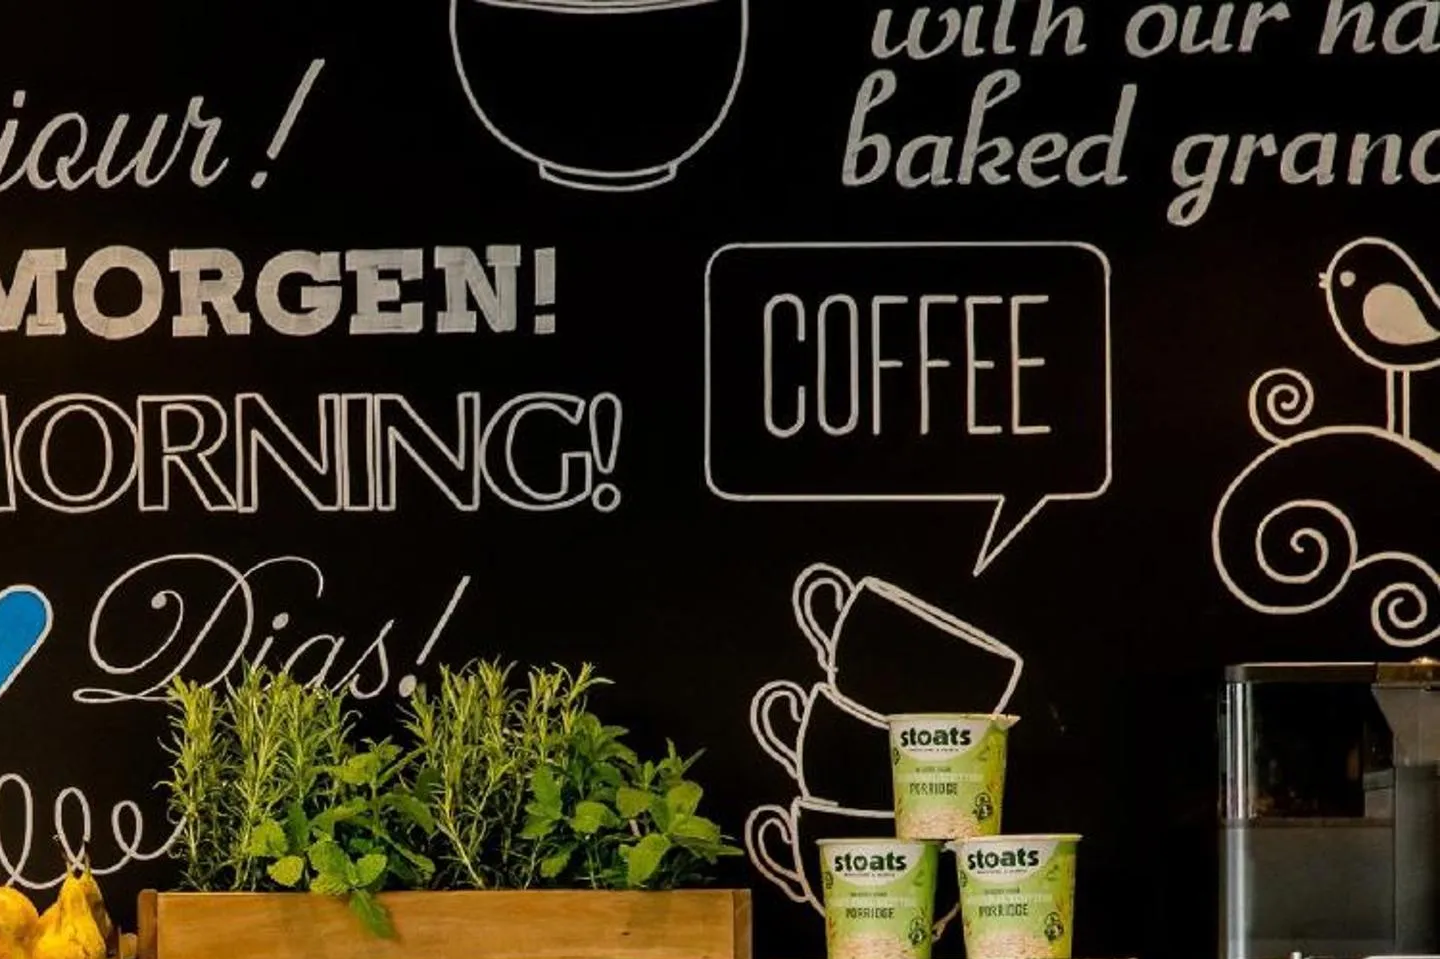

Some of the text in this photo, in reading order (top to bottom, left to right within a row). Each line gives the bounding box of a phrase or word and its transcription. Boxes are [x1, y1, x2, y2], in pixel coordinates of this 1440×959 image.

[1126, 3, 1289, 57] our
[843, 70, 1136, 187] baked
[764, 294, 1050, 437] COFFEE
[900, 727, 971, 747] stoats
[834, 852, 907, 872] stoats
[967, 848, 1039, 870] stoats
